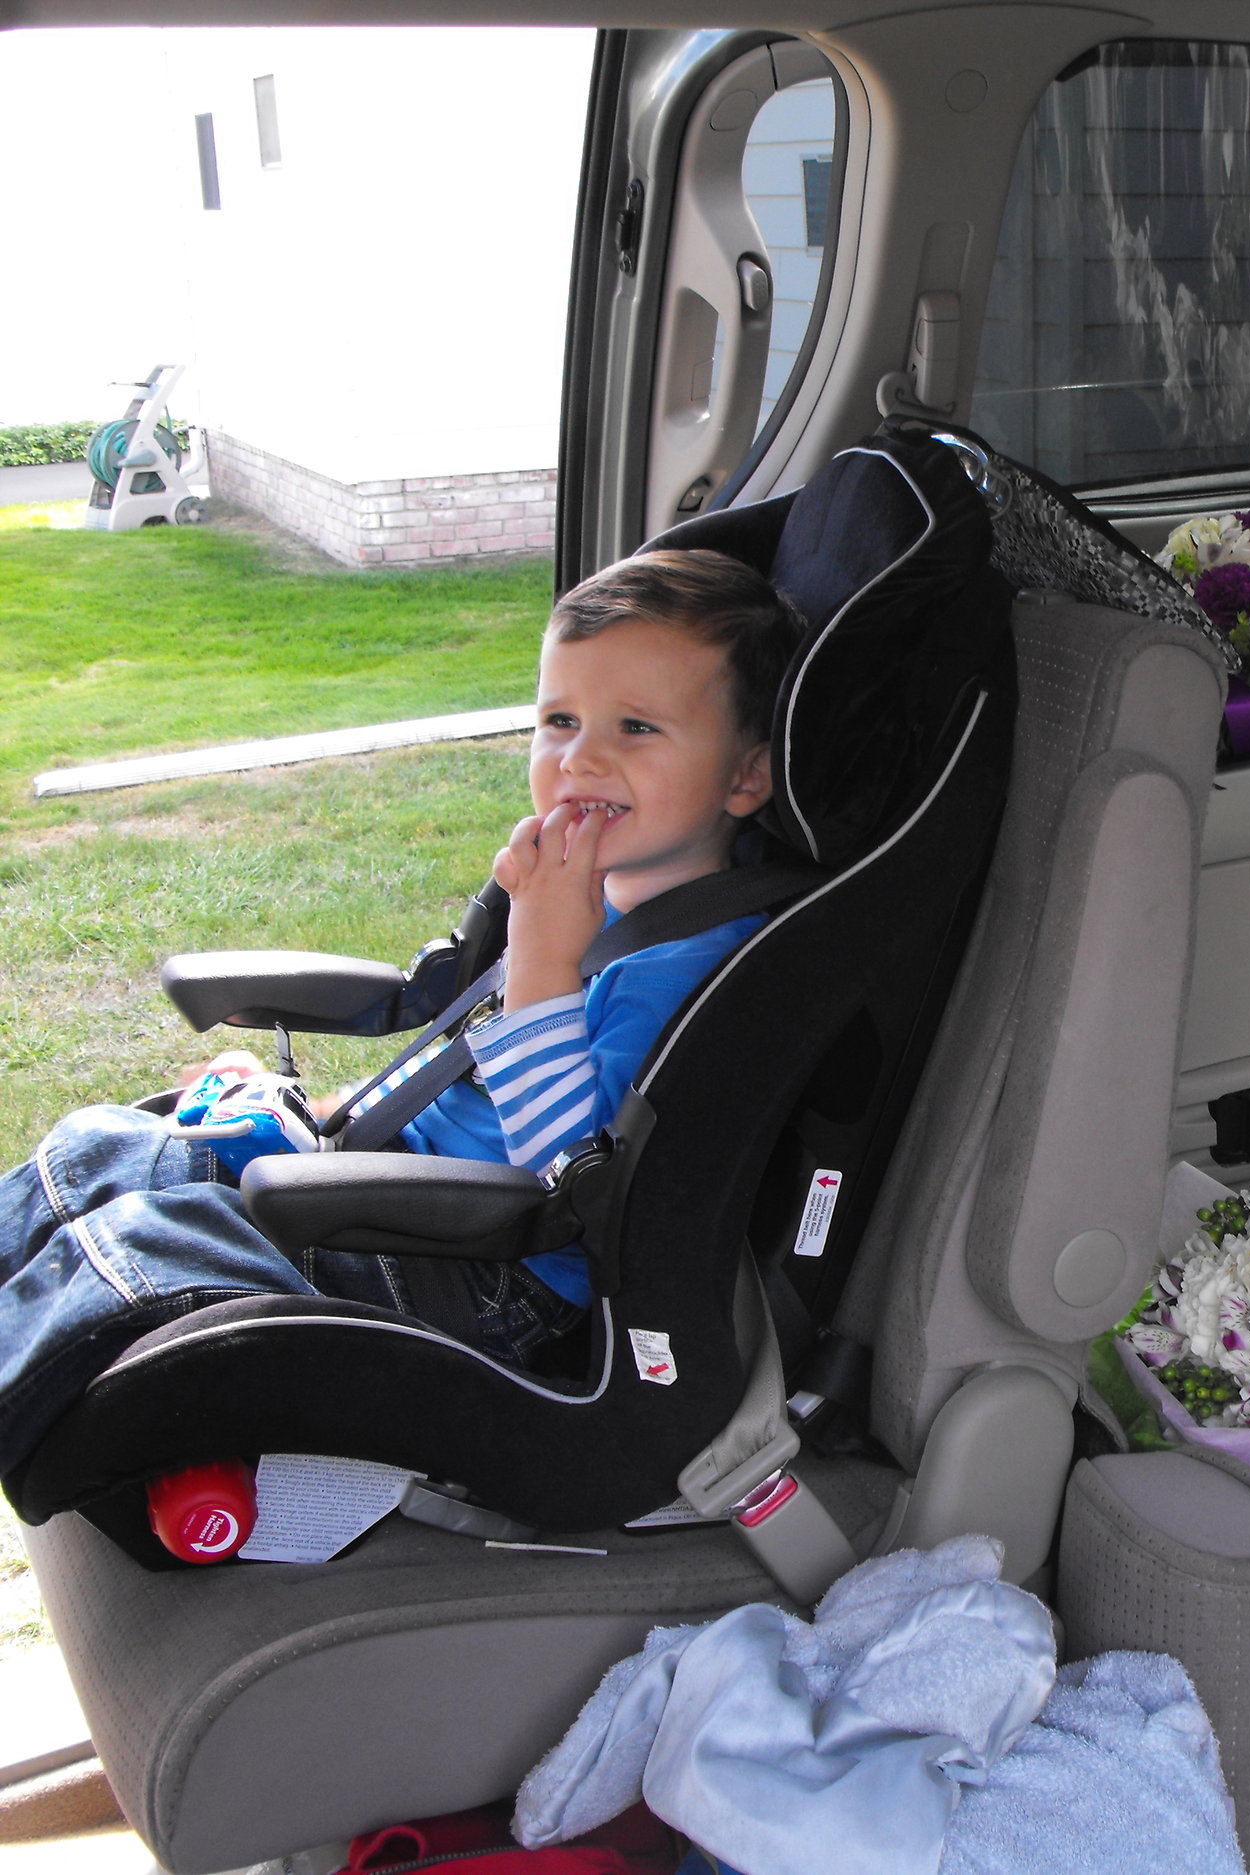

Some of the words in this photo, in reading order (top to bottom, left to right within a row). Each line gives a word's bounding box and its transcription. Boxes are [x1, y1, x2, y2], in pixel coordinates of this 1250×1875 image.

[798, 1232, 807, 1249] Thread
[199, 1514, 217, 1539] Harness
[206, 1518, 224, 1542] Tighten
